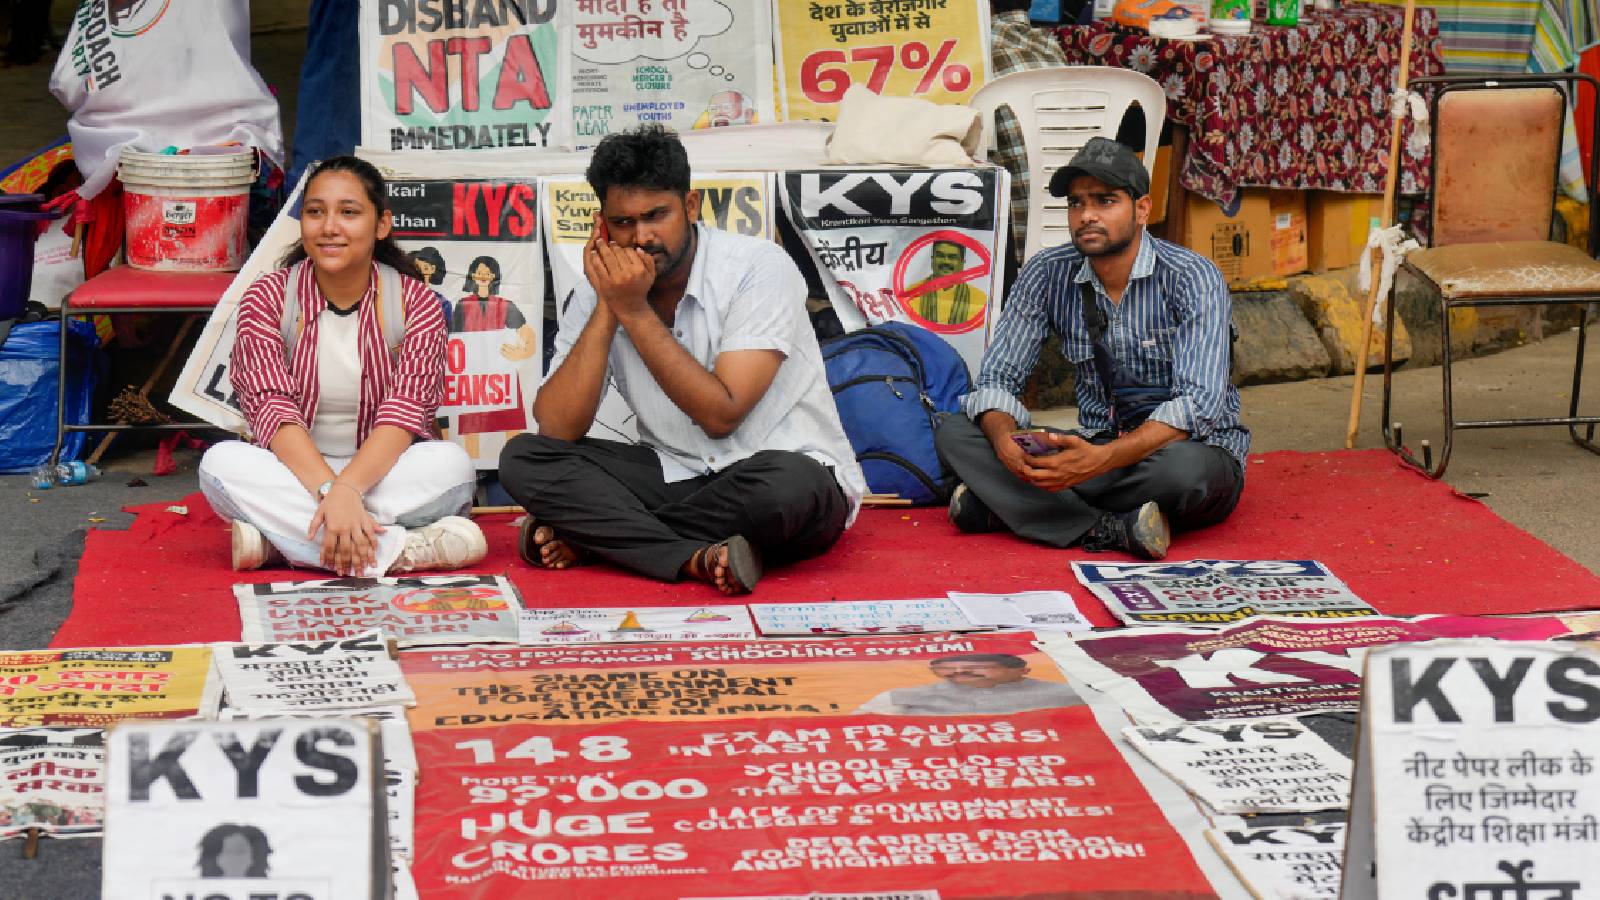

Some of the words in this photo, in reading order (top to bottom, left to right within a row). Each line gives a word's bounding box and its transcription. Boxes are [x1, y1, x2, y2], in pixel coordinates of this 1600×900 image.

[379, 0, 557, 35] DISBAND
[809, 2, 842, 21] देश
[913, 11, 930, 29] से
[670, 12, 690, 41] है
[392, 34, 551, 115] NTA
[801, 39, 971, 103] 67%
[573, 105, 614, 120] PAPER
[623, 101, 685, 111] UNEMPLOYED
[637, 112, 672, 121] YOUTHS
[390, 122, 552, 150] IMMEDIATELY
[576, 119, 611, 136] LEAK
[801, 172, 984, 217] KYS
[453, 182, 535, 237] KYS
[443, 373, 512, 406] EAKS!
[267, 594, 378, 607] SACK
[267, 603, 390, 618] UNION
[539, 654, 672, 665] COMMON
[691, 647, 857, 661] SCHOOLING
[865, 642, 974, 656] SYSTEM!
[452, 684, 523, 696] THE
[535, 676, 796, 693] GOVERNMENT
[532, 672, 660, 683] SHAME
[672, 668, 726, 679] ON
[478, 694, 553, 705] FOR
[570, 690, 637, 701] THE
[1390, 656, 1600, 723] KYS
[544, 699, 661, 710] STATE
[672, 697, 718, 708] OF
[668, 744, 713, 756] IN
[724, 740, 831, 756] LAST
[845, 738, 889, 751] 12
[899, 729, 1061, 748] YEARS!
[702, 728, 831, 745] EXAM
[843, 721, 1016, 739] FRAUDS
[1136, 721, 1304, 743] KYS
[455, 736, 632, 765] 148
[127, 727, 359, 803] KYS
[744, 757, 912, 776] SCHOOLS
[923, 754, 1067, 769] CLOSED
[767, 772, 843, 785] AND
[853, 766, 1008, 783] MERGED
[1017, 766, 1055, 777] IN
[1402, 751, 1446, 778] नीट
[1452, 751, 1500, 778] पेपर
[1506, 750, 1563, 777] लीक
[1567, 750, 1594, 776] के
[462, 775, 537, 785] MORE
[731, 784, 802, 796] THE
[812, 782, 900, 795] LAST
[913, 780, 952, 791] 10
[961, 775, 1096, 789] YEARS!
[708, 806, 792, 820] LACK
[803, 805, 844, 816] OF
[853, 796, 1068, 817] GOVERNMENT
[1425, 784, 1473, 811] लिए
[1479, 783, 1578, 811] जिम्मेदार
[461, 808, 654, 840] HUGE
[673, 815, 839, 832] COLLEGES
[849, 815, 873, 826] &
[890, 805, 1114, 824] UNIVERSITIES!
[1405, 816, 1476, 847] केंद्रीय
[1482, 815, 1547, 847] शिक्षा
[1553, 814, 1600, 842] मंत्री
[741, 845, 879, 861] FORMAL
[992, 835, 1126, 851] SCHOOL
[787, 831, 969, 849] DEBARRED
[977, 829, 1073, 843] FROM
[1224, 827, 1343, 845] KY
[452, 840, 689, 869] CRORES
[732, 857, 802, 872] AND
[810, 853, 937, 871] HIGHER
[945, 843, 1147, 864] EDUCATION!
